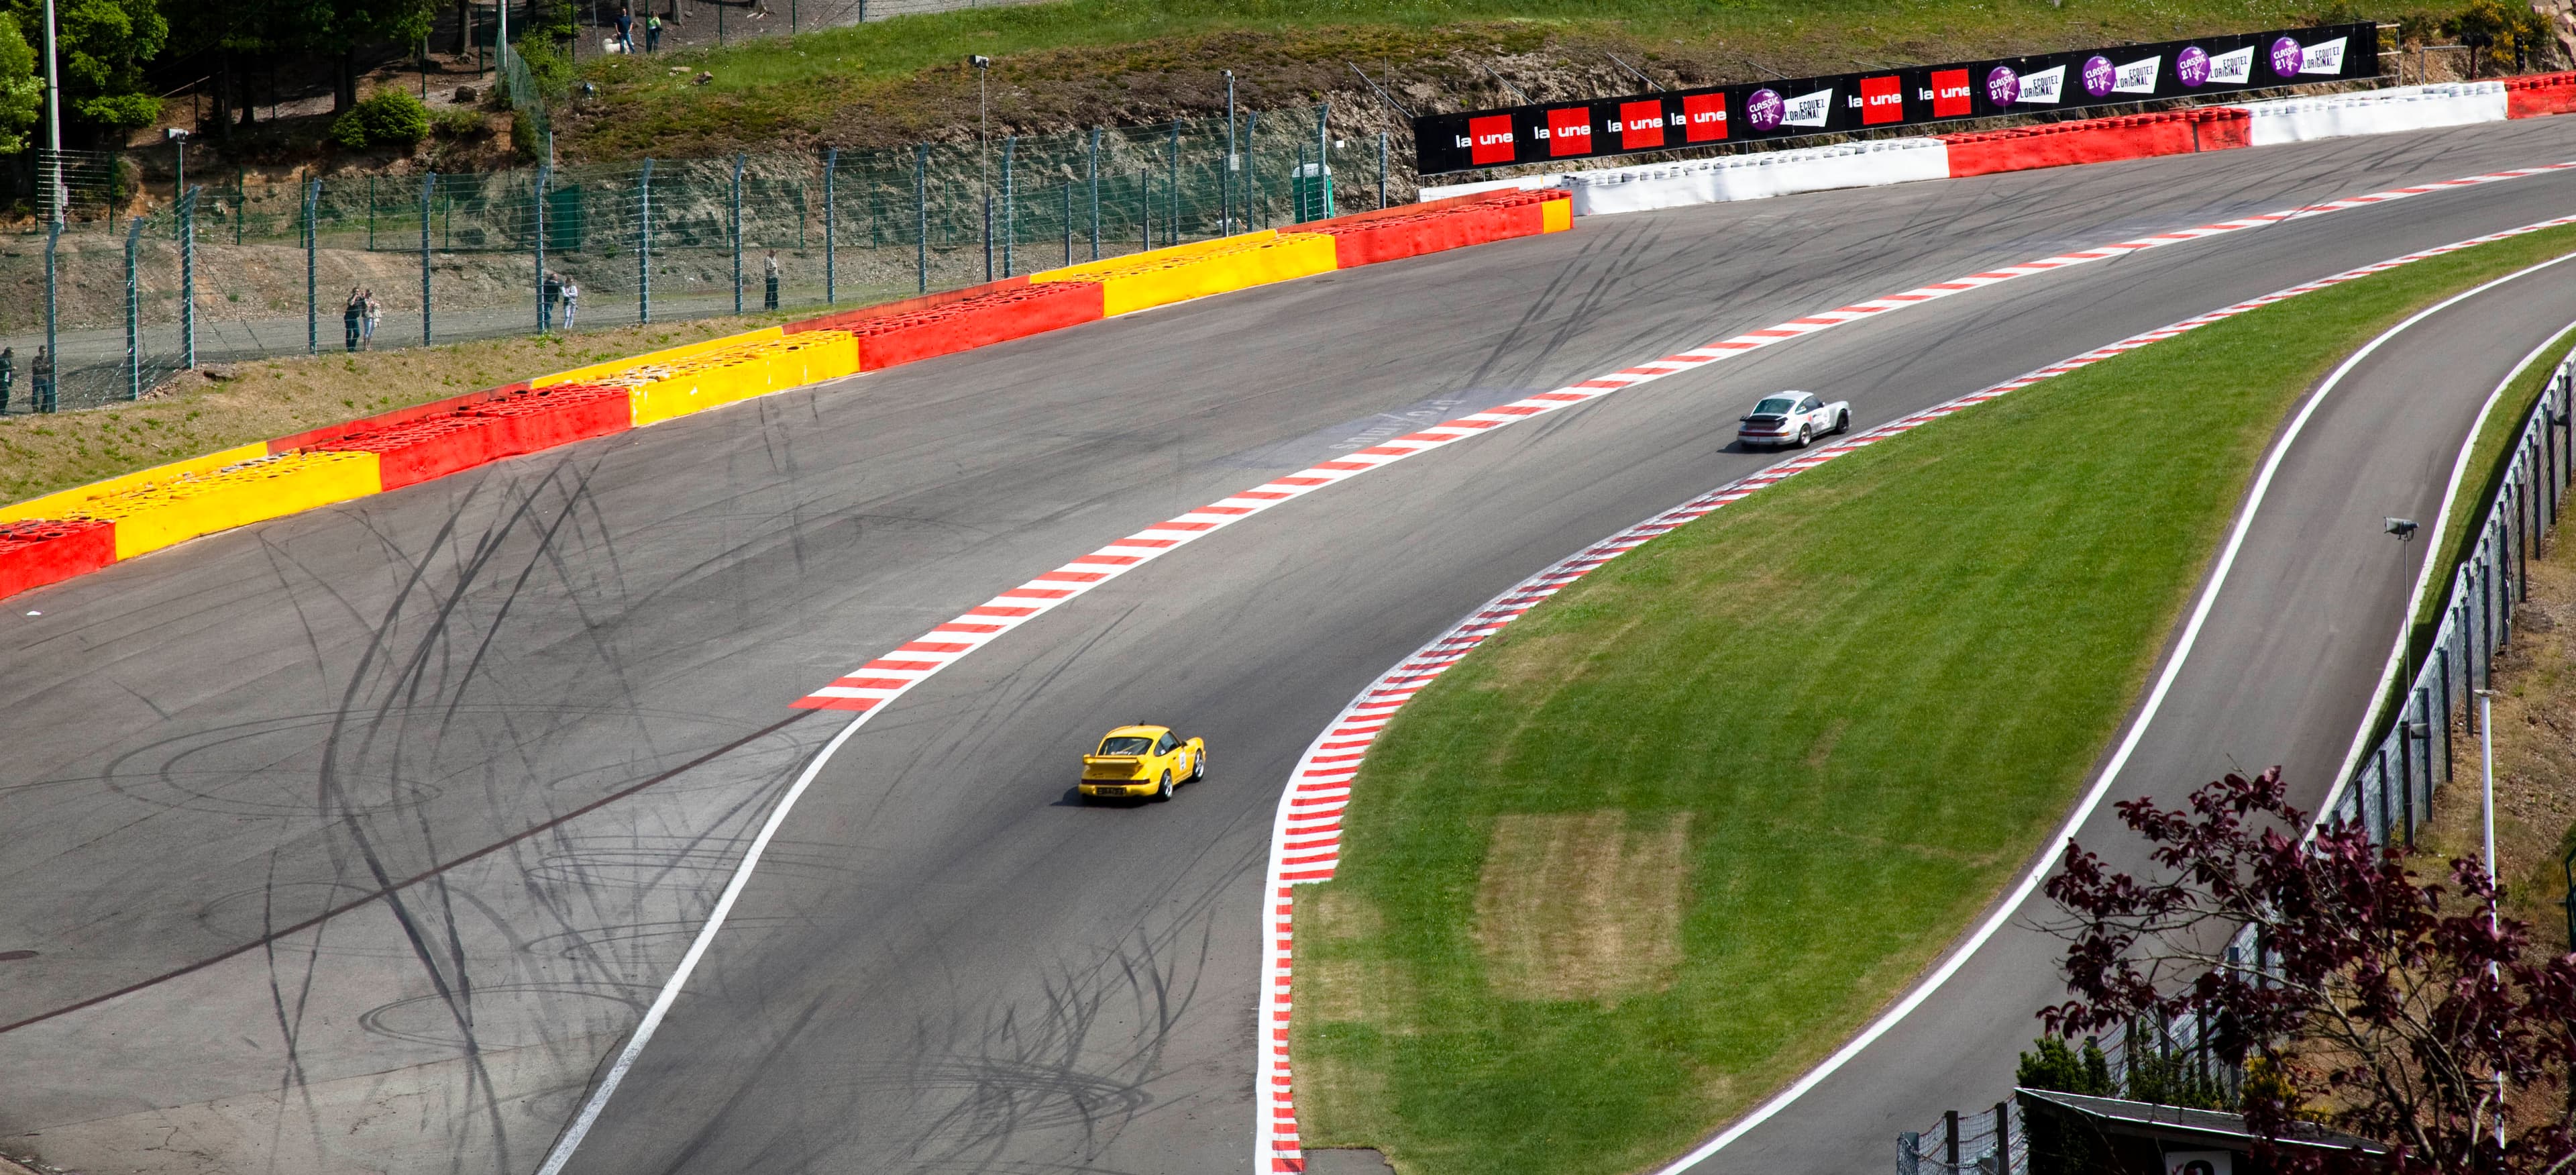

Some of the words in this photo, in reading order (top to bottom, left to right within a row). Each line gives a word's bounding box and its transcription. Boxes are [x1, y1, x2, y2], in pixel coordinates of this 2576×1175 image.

[2273, 45, 2298, 60] CLASSIC
[2315, 46, 2339, 59] ECOUTEZ
[2180, 54, 2206, 70] CLASSIC
[2223, 56, 2247, 68] ECOUTEZ
[2275, 58, 2286, 70] 21
[2085, 64, 2112, 79] CLASSIC
[2129, 66, 2153, 79] ECOUTEZ
[2181, 69, 2192, 80] 21
[1989, 74, 2015, 89] CLASSIC
[2033, 75, 2058, 88] ECOUTEZ
[2087, 77, 2098, 90] 21
[1919, 88, 1934, 100] la
[1941, 86, 1971, 99] une
[1991, 88, 2002, 100] 21
[1749, 96, 1780, 113] CLASSIC
[1848, 95, 1863, 108] la
[1870, 93, 1902, 106] une
[1671, 113, 1686, 125] la
[1694, 110, 1727, 123] une
[1751, 111, 1763, 123] 21
[1607, 119, 1622, 133] la
[1630, 117, 1663, 130] une
[1534, 126, 1550, 140] la
[1558, 125, 1591, 138] une
[1455, 135, 1472, 148] la
[1480, 132, 1513, 146] une
